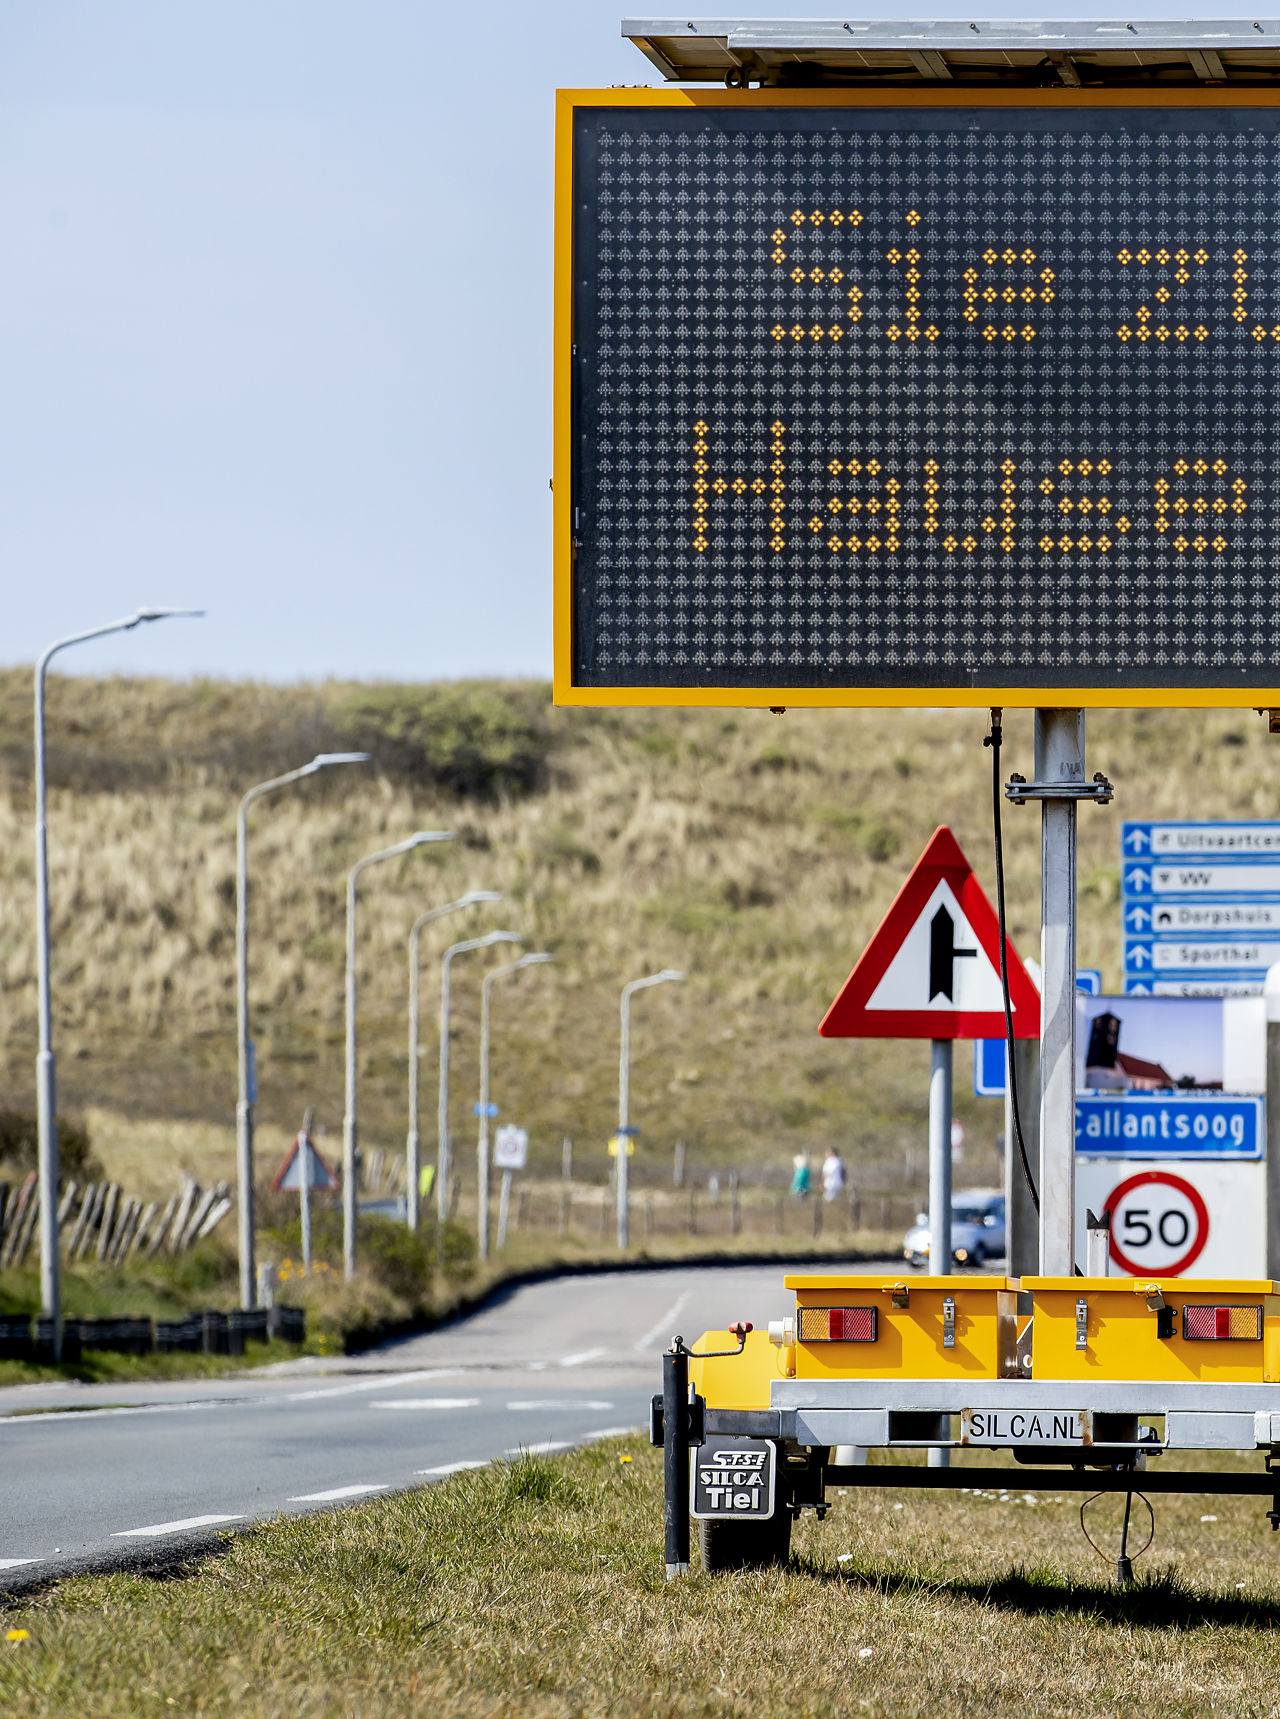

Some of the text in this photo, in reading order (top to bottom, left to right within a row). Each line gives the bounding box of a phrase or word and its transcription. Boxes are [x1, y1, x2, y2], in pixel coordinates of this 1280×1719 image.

[771, 209, 1056, 342] Sie
[693, 420, 1247, 553] Hause
[1179, 908, 1272, 926] Dorpshuis
[1181, 946, 1259, 963] Sporthal
[1123, 1209, 1189, 1247] 50
[970, 1413, 1084, 1439] SILCA.NL
[700, 1471, 765, 1486] SILCA
[705, 1487, 759, 1509] Tiel
